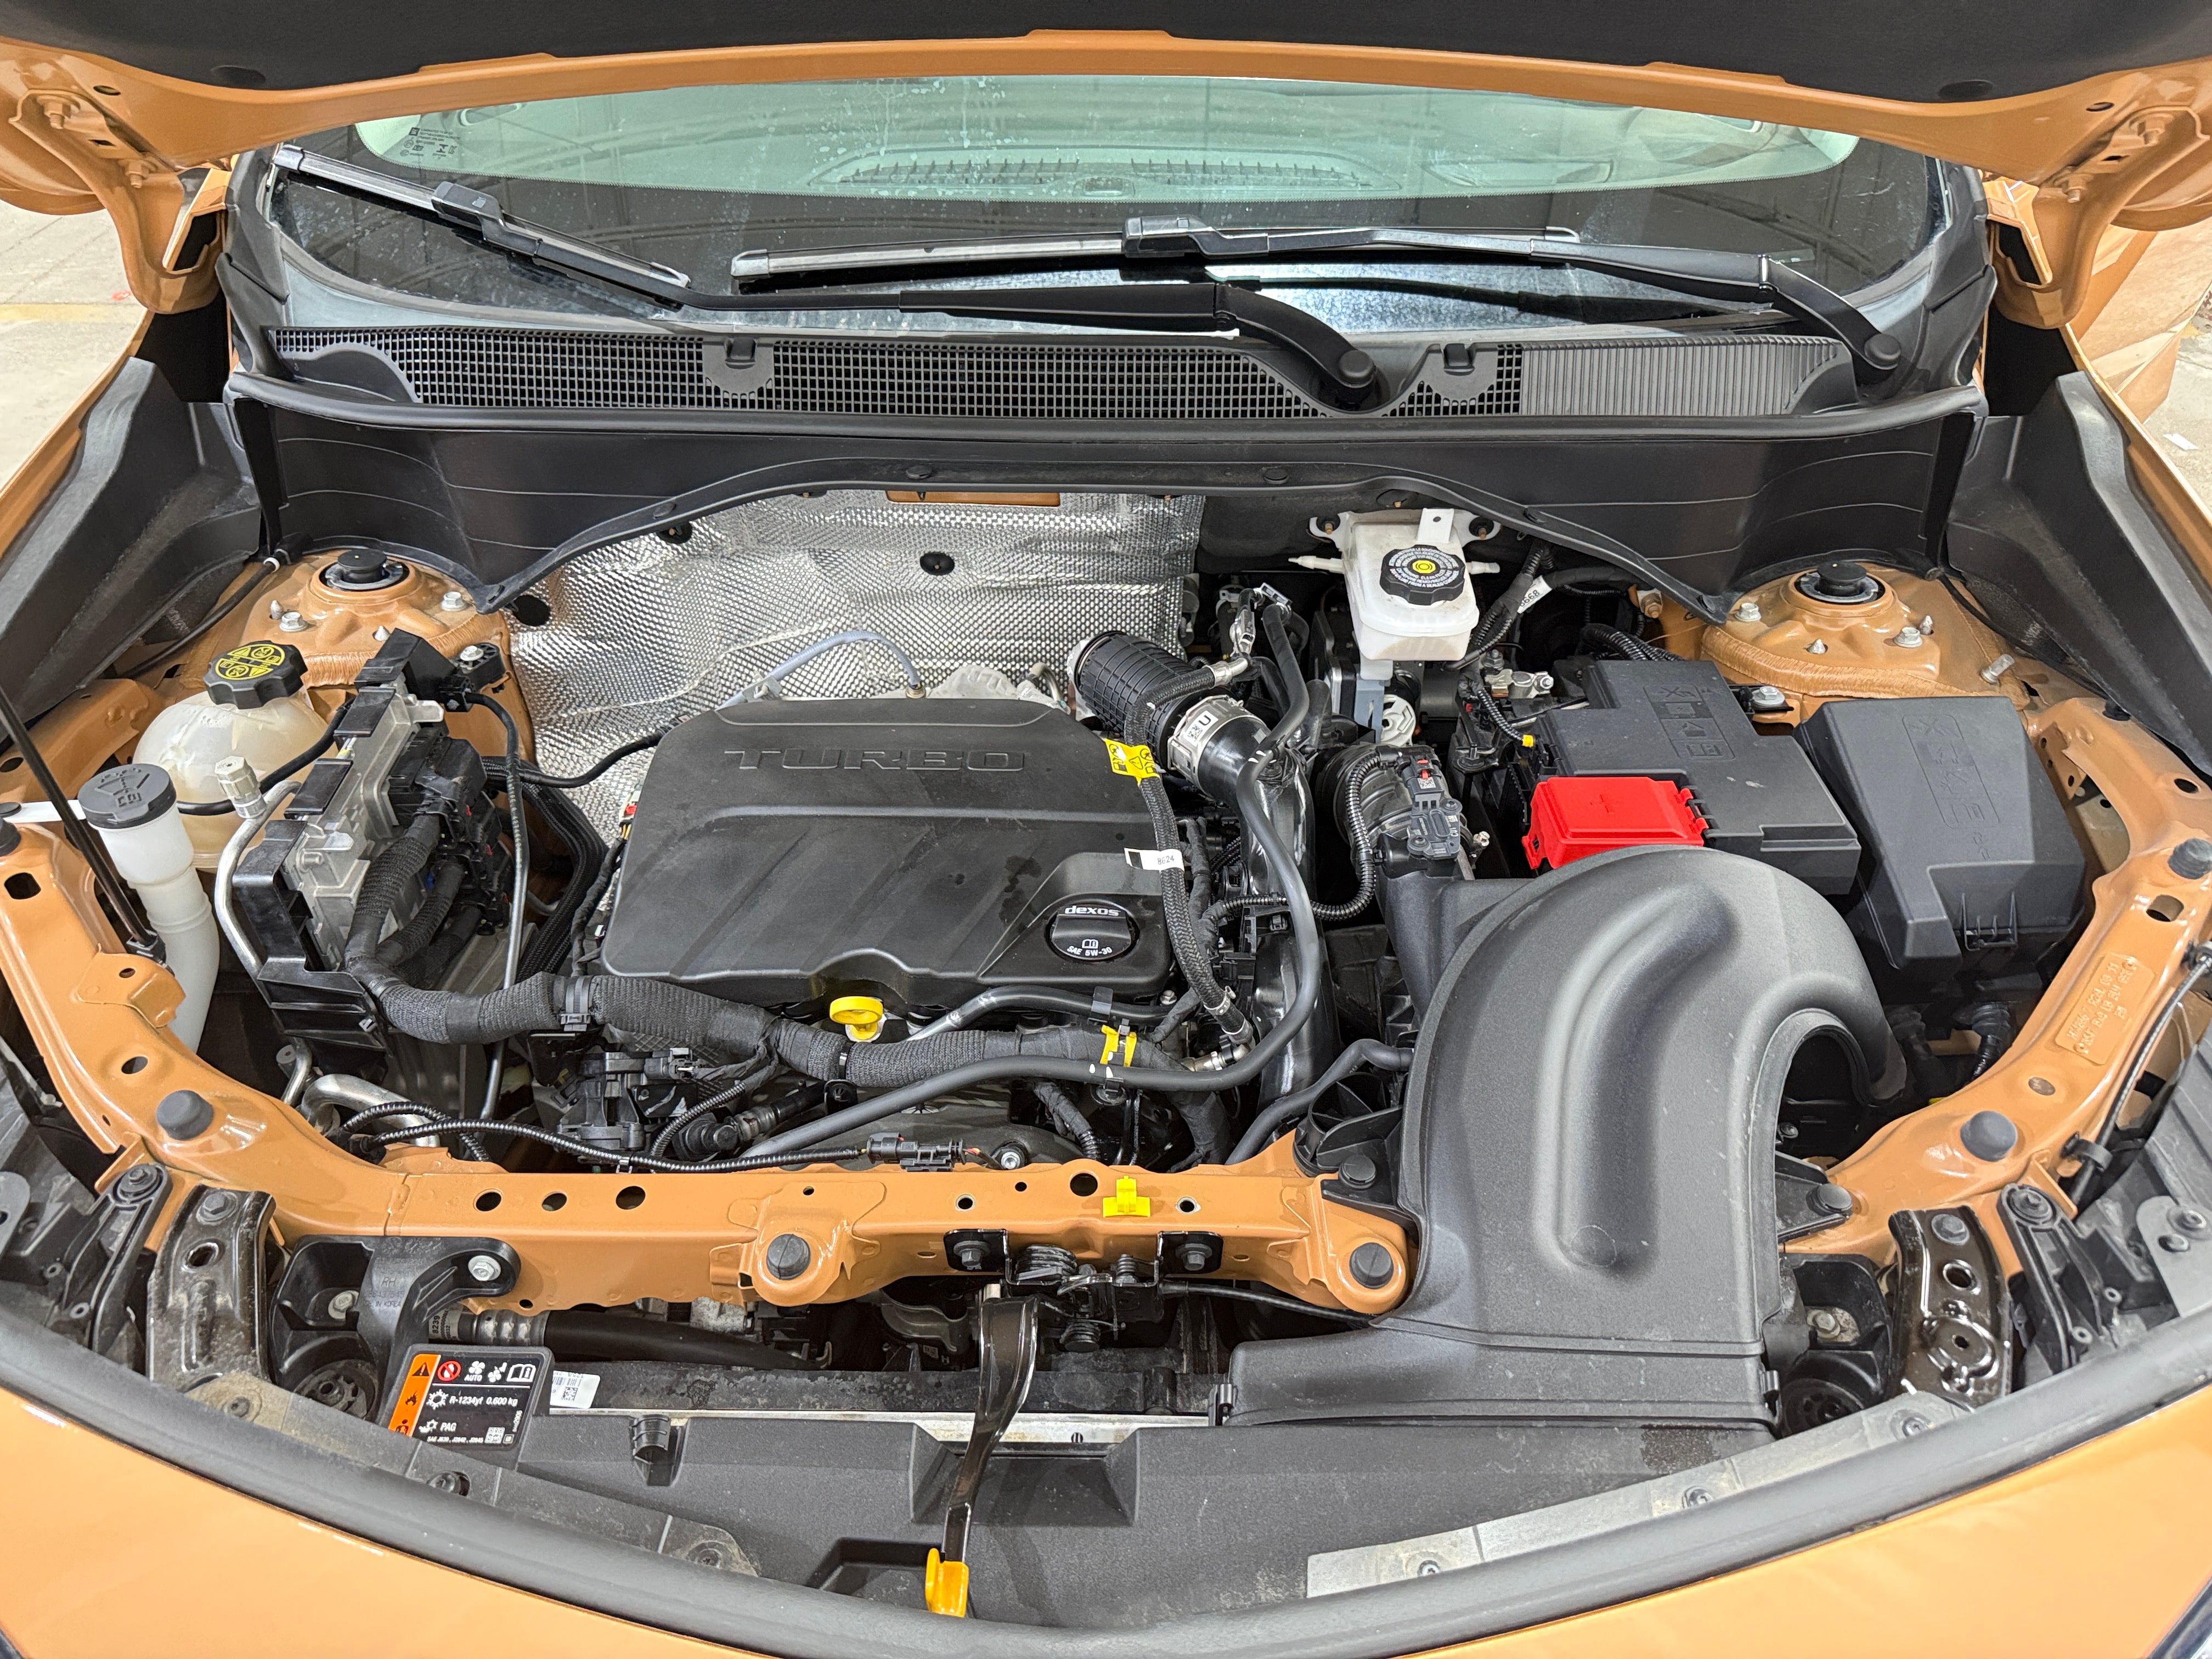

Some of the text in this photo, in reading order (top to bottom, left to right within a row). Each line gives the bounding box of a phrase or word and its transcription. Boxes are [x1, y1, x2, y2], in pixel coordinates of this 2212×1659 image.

[723, 749, 1024, 771] TURBO
[1157, 855, 1175, 865] 8624
[1064, 905, 1121, 916] dexos
[1067, 946, 1112, 956] SAE 5W-30
[381, 1277, 396, 1286] RH
[432, 1315, 440, 1334] 8239
[449, 1396, 518, 1407] R-1234yf 0.600 kg
[440, 1422, 457, 1432] PAG
